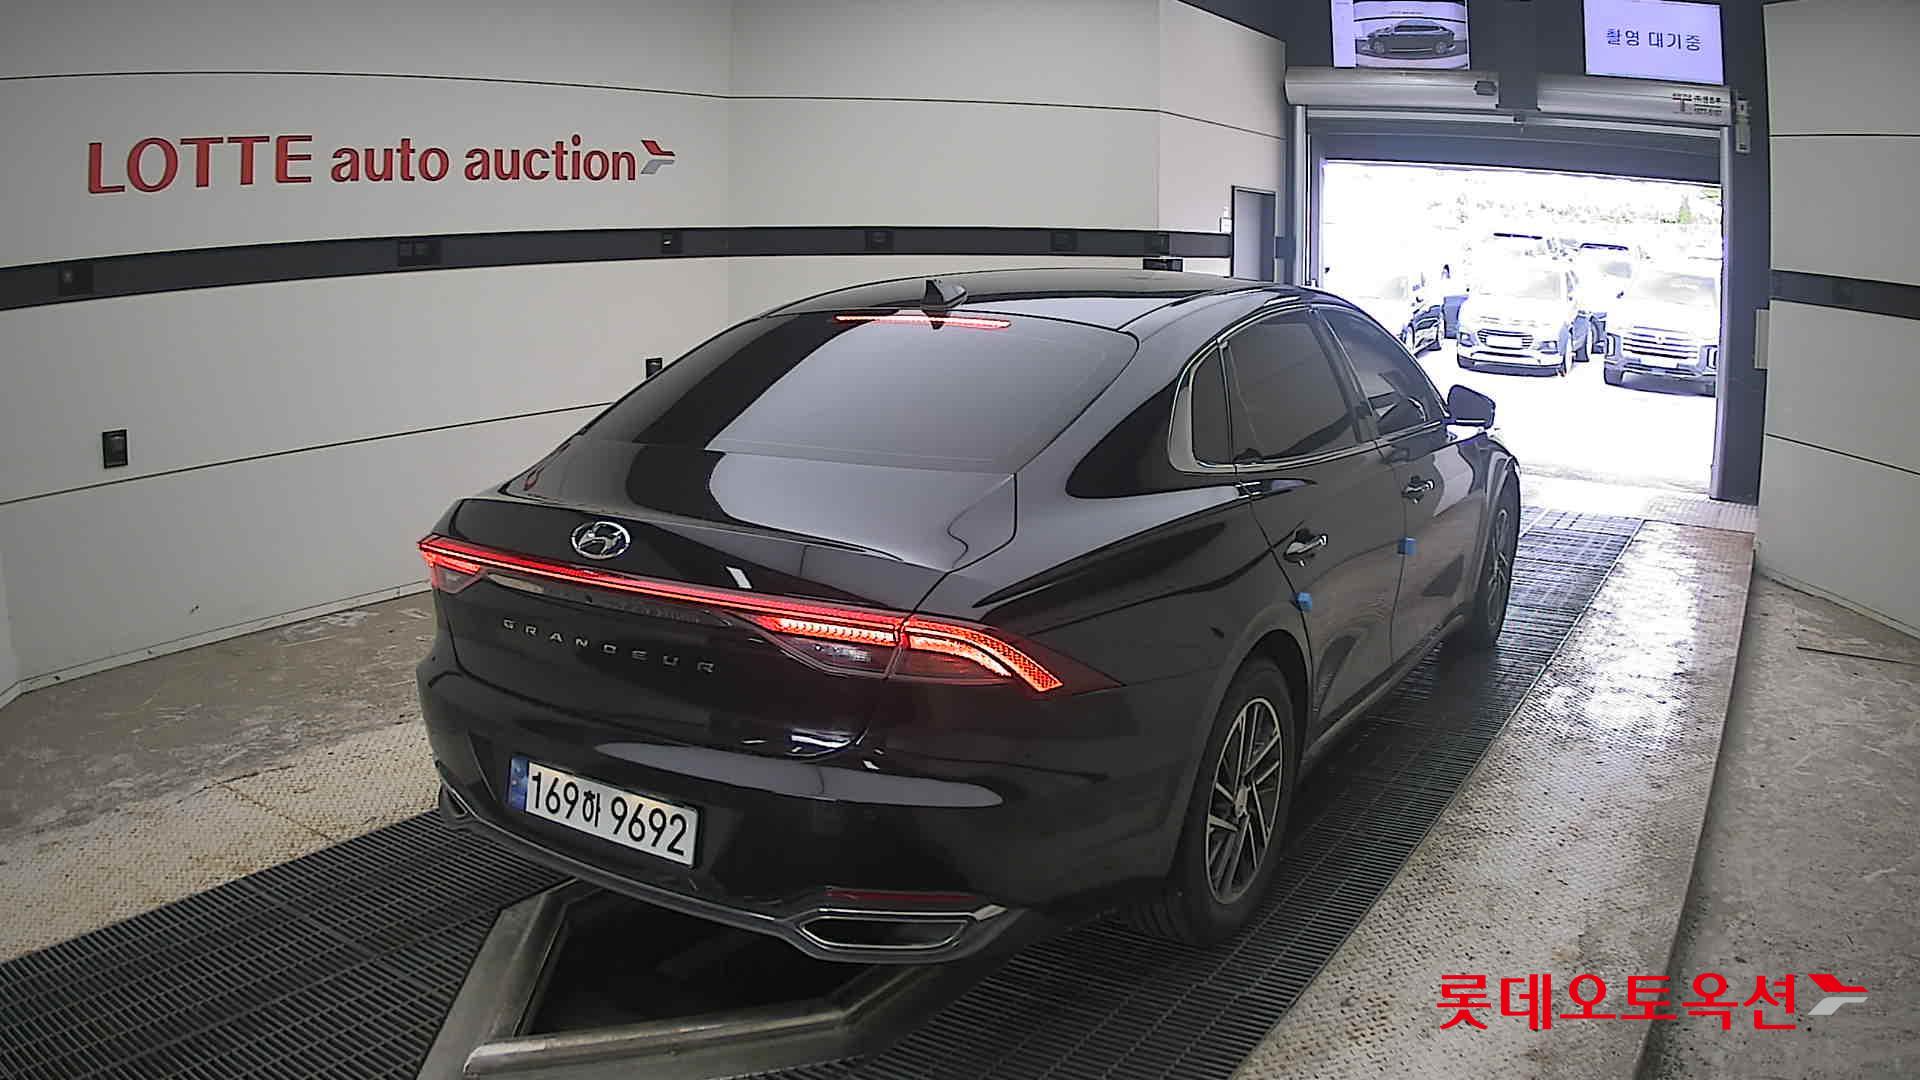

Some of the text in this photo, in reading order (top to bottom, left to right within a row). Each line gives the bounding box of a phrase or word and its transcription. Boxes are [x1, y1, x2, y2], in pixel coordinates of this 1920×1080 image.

[1647, 31, 1701, 52] 대기중
[88, 134, 637, 195] LOTTE auto auction
[502, 617, 716, 673] GRANDEUR
[531, 771, 687, 857] 169하 9692
